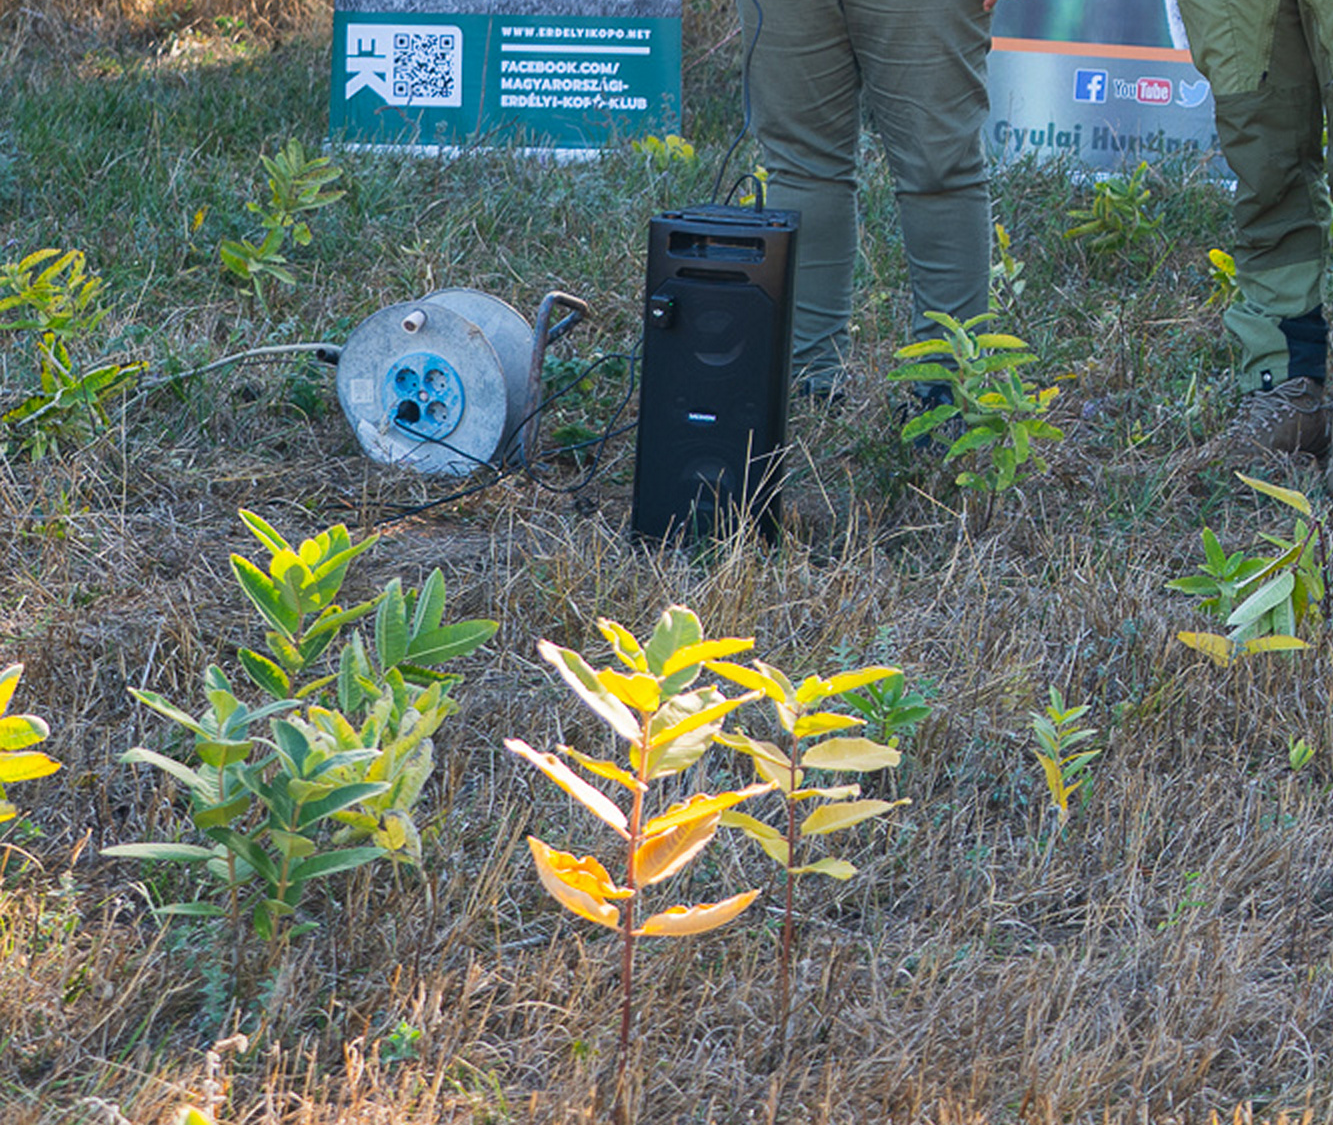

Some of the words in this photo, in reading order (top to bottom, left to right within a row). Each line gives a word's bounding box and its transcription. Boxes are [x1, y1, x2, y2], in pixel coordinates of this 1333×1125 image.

[501, 27, 651, 40] WWW.ERDELYIKOPO.NET
[501, 60, 620, 75] FACEBOOK.COM/
[994, 120, 1082, 156] Gyulaj
